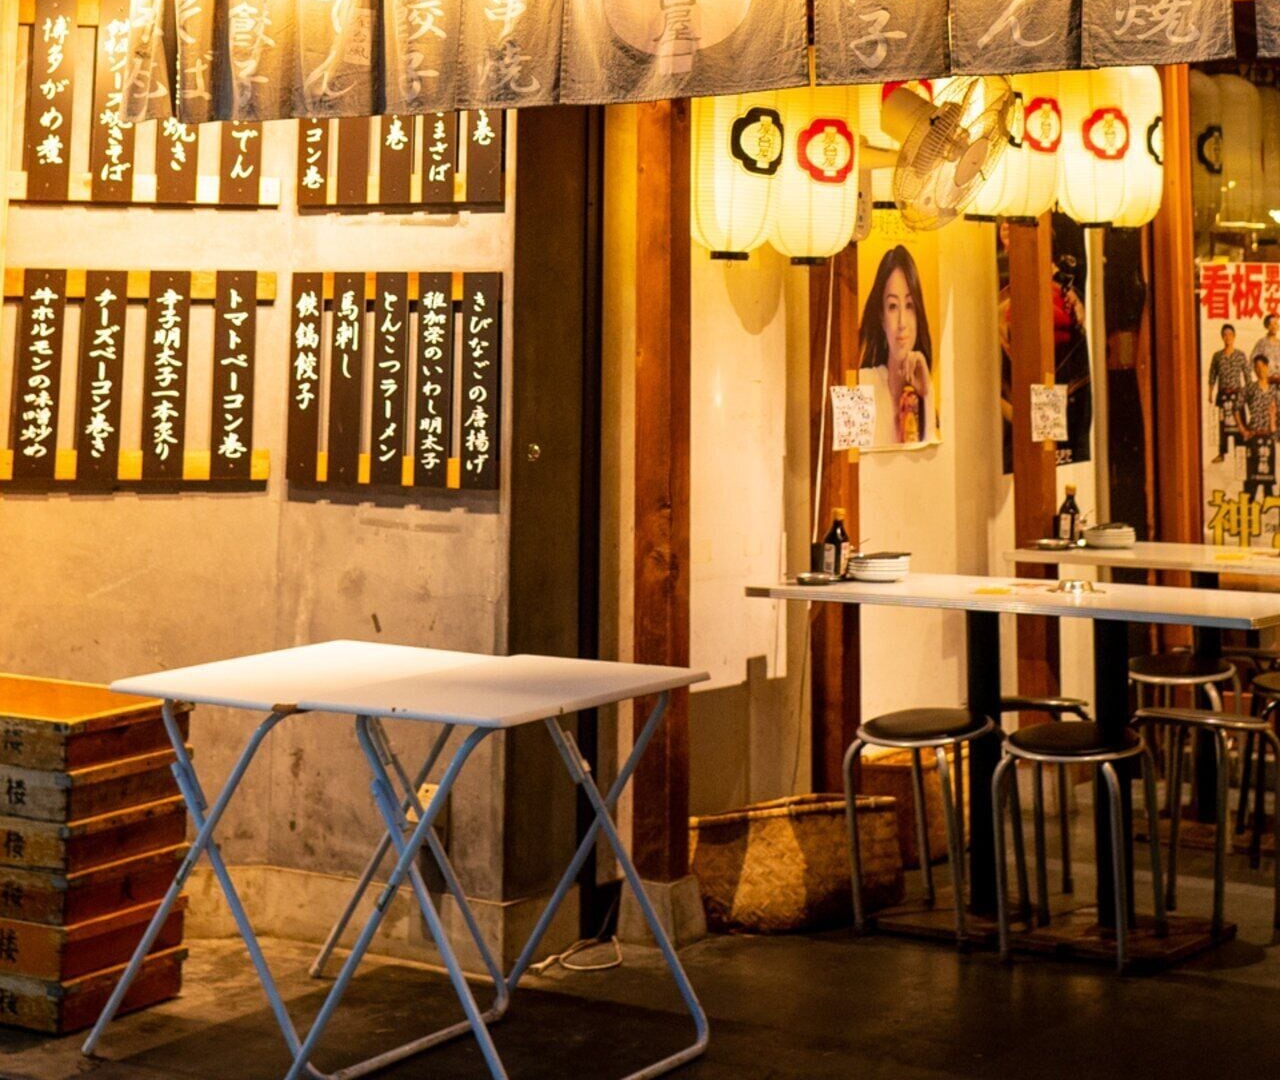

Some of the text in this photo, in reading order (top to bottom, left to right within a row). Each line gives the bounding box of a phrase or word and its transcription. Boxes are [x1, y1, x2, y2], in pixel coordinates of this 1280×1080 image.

[36, 14, 71, 166] 博多がめ煮
[19, 286, 59, 459] 牛ホルモンの味噌炒め
[85, 288, 121, 459] チーズベーコン巻き
[218, 288, 249, 459] トマトベーコン巻
[294, 290, 320, 411] 鉄鍋餃子
[335, 290, 360, 379] 馬刺し
[378, 291, 402, 462] とんこつラーメン
[1200, 264, 1264, 320] 看板
[464, 291, 493, 474] きびなごの唐揚げ
